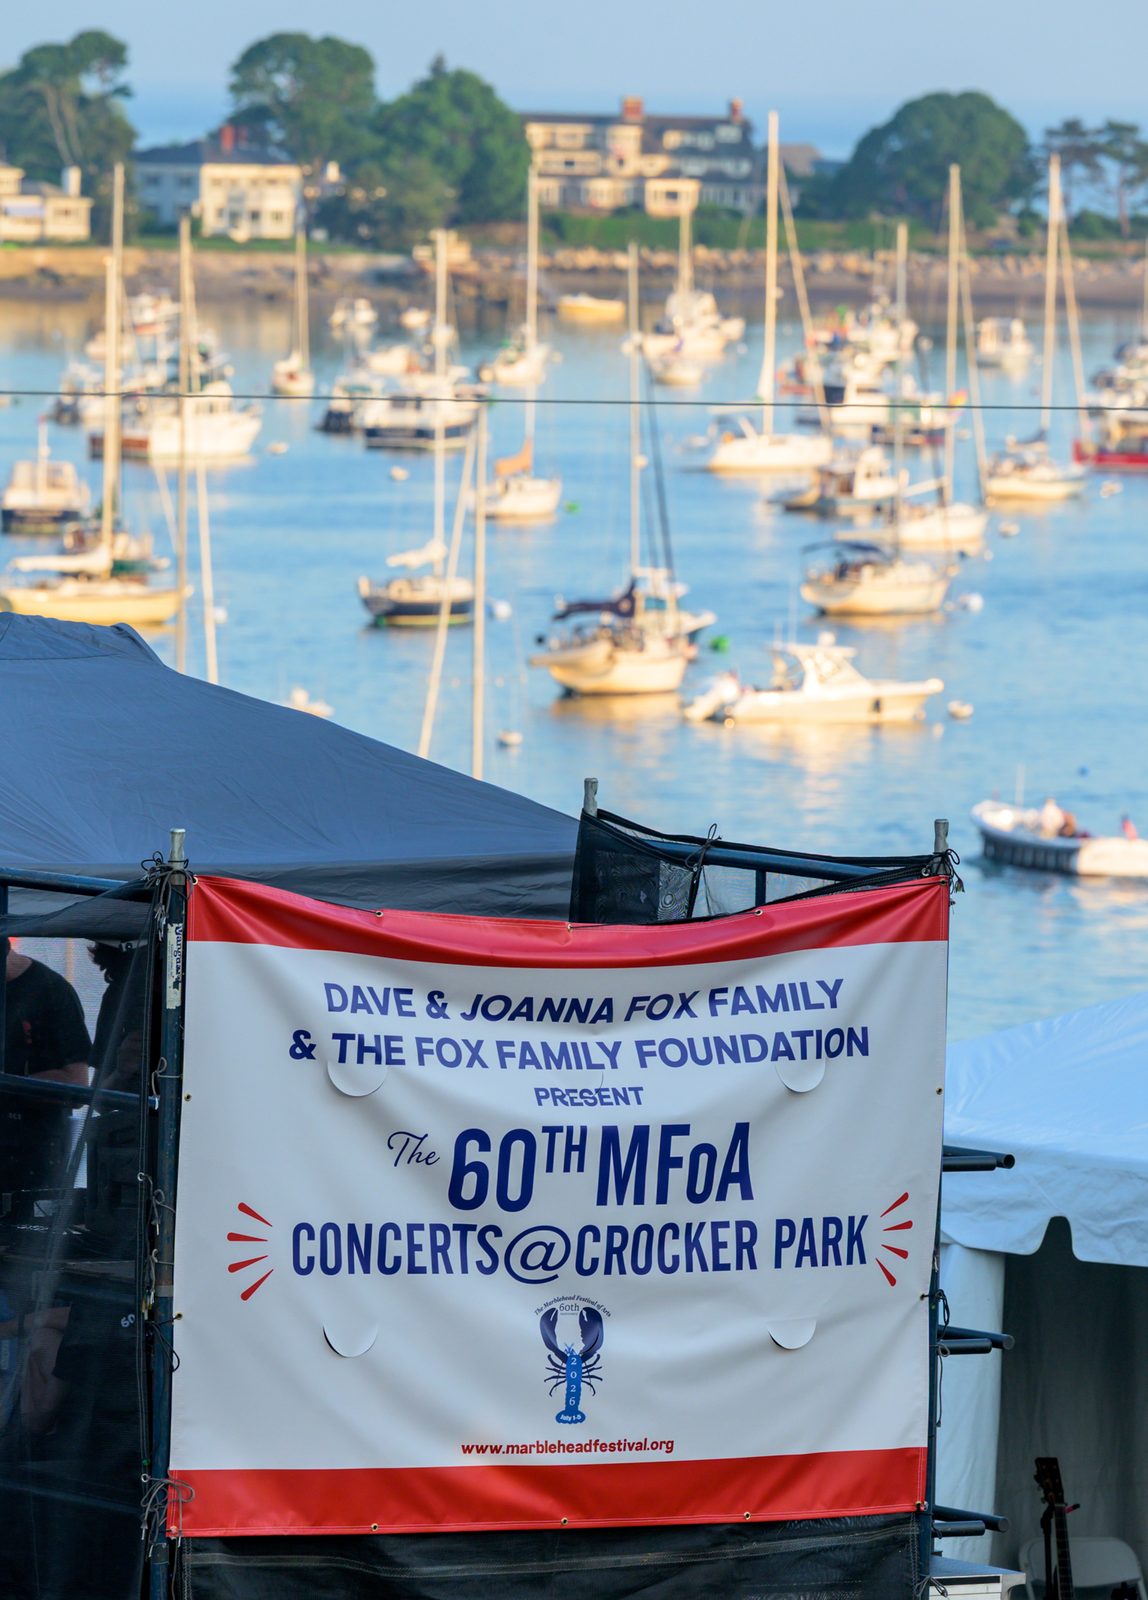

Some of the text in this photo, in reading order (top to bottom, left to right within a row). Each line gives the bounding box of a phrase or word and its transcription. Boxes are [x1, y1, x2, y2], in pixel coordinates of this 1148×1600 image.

[324, 979, 844, 1025] DAVE & JOANNA FOX FAMILY
[289, 1026, 870, 1070] & THE FOX FAMILY FOUNDATION
[534, 1086, 644, 1107] PRESENT
[387, 1122, 754, 1212] The 60TH MFoA
[774, 1215, 869, 1271] PARK
[534, 1306, 544, 1315] The
[543, 1294, 575, 1308] Marblehead
[575, 1295, 598, 1306] Festival
[600, 1306, 611, 1317] Arts
[559, 1303, 580, 1312] 60th
[461, 1438, 674, 1455] www.marbleheadfestival.org
